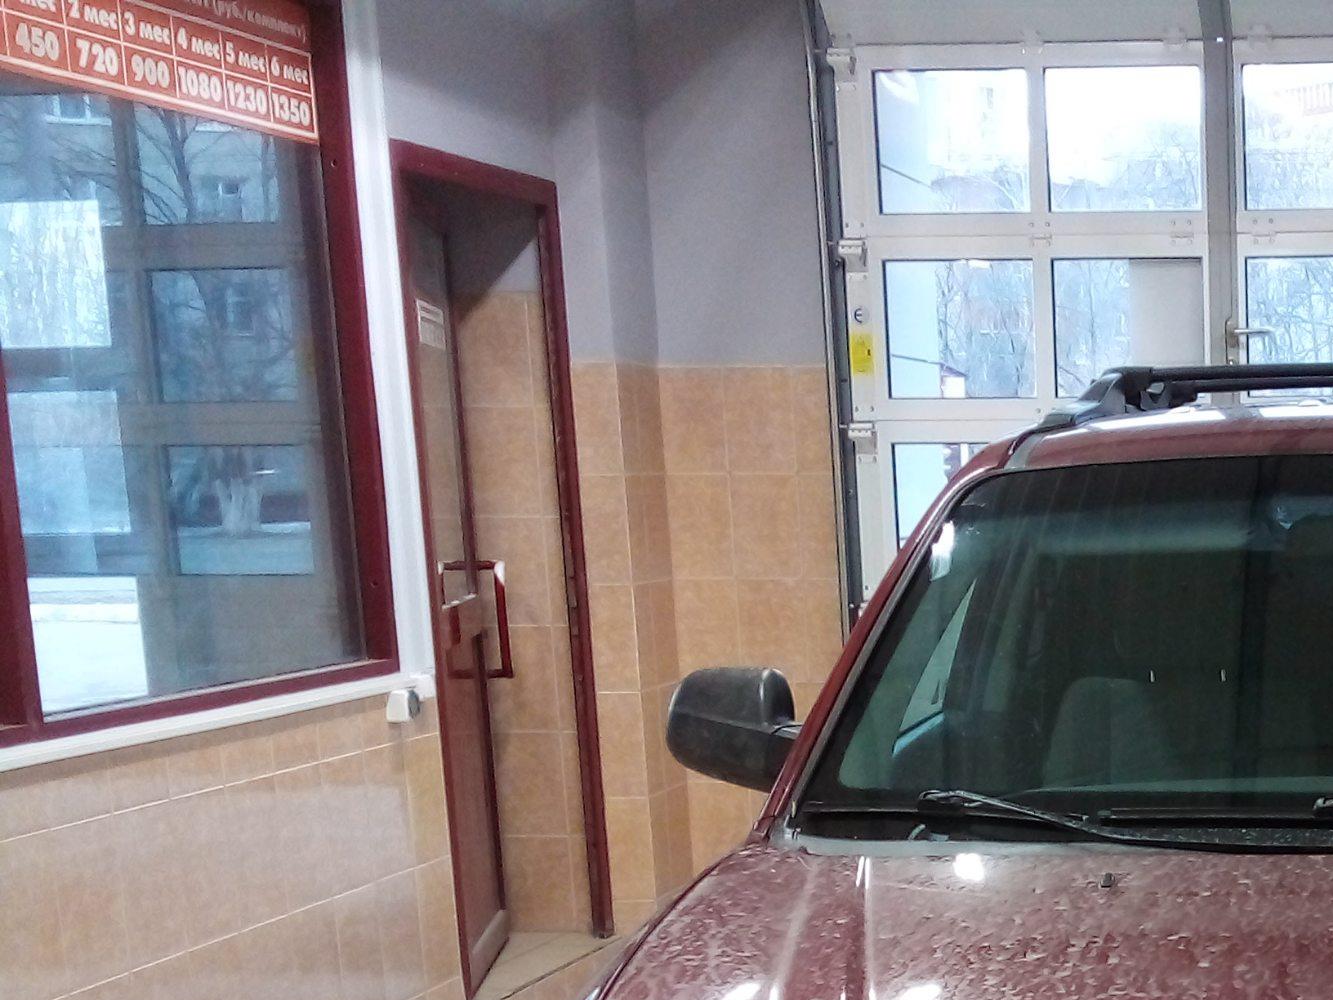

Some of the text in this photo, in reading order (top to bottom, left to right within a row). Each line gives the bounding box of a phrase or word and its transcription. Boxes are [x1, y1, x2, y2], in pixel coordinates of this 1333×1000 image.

[84, 4, 119, 29] мес
[124, 11, 171, 45] 3 мес
[15, 22, 60, 61] 450
[75, 38, 119, 77] 720
[176, 26, 220, 60] 4 мес
[225, 41, 266, 73] 5 мес
[131, 53, 170, 88] 900
[177, 65, 222, 102] 1080
[271, 56, 309, 85] 6 мес
[226, 79, 268, 116] 1230
[271, 92, 311, 127] 1350
